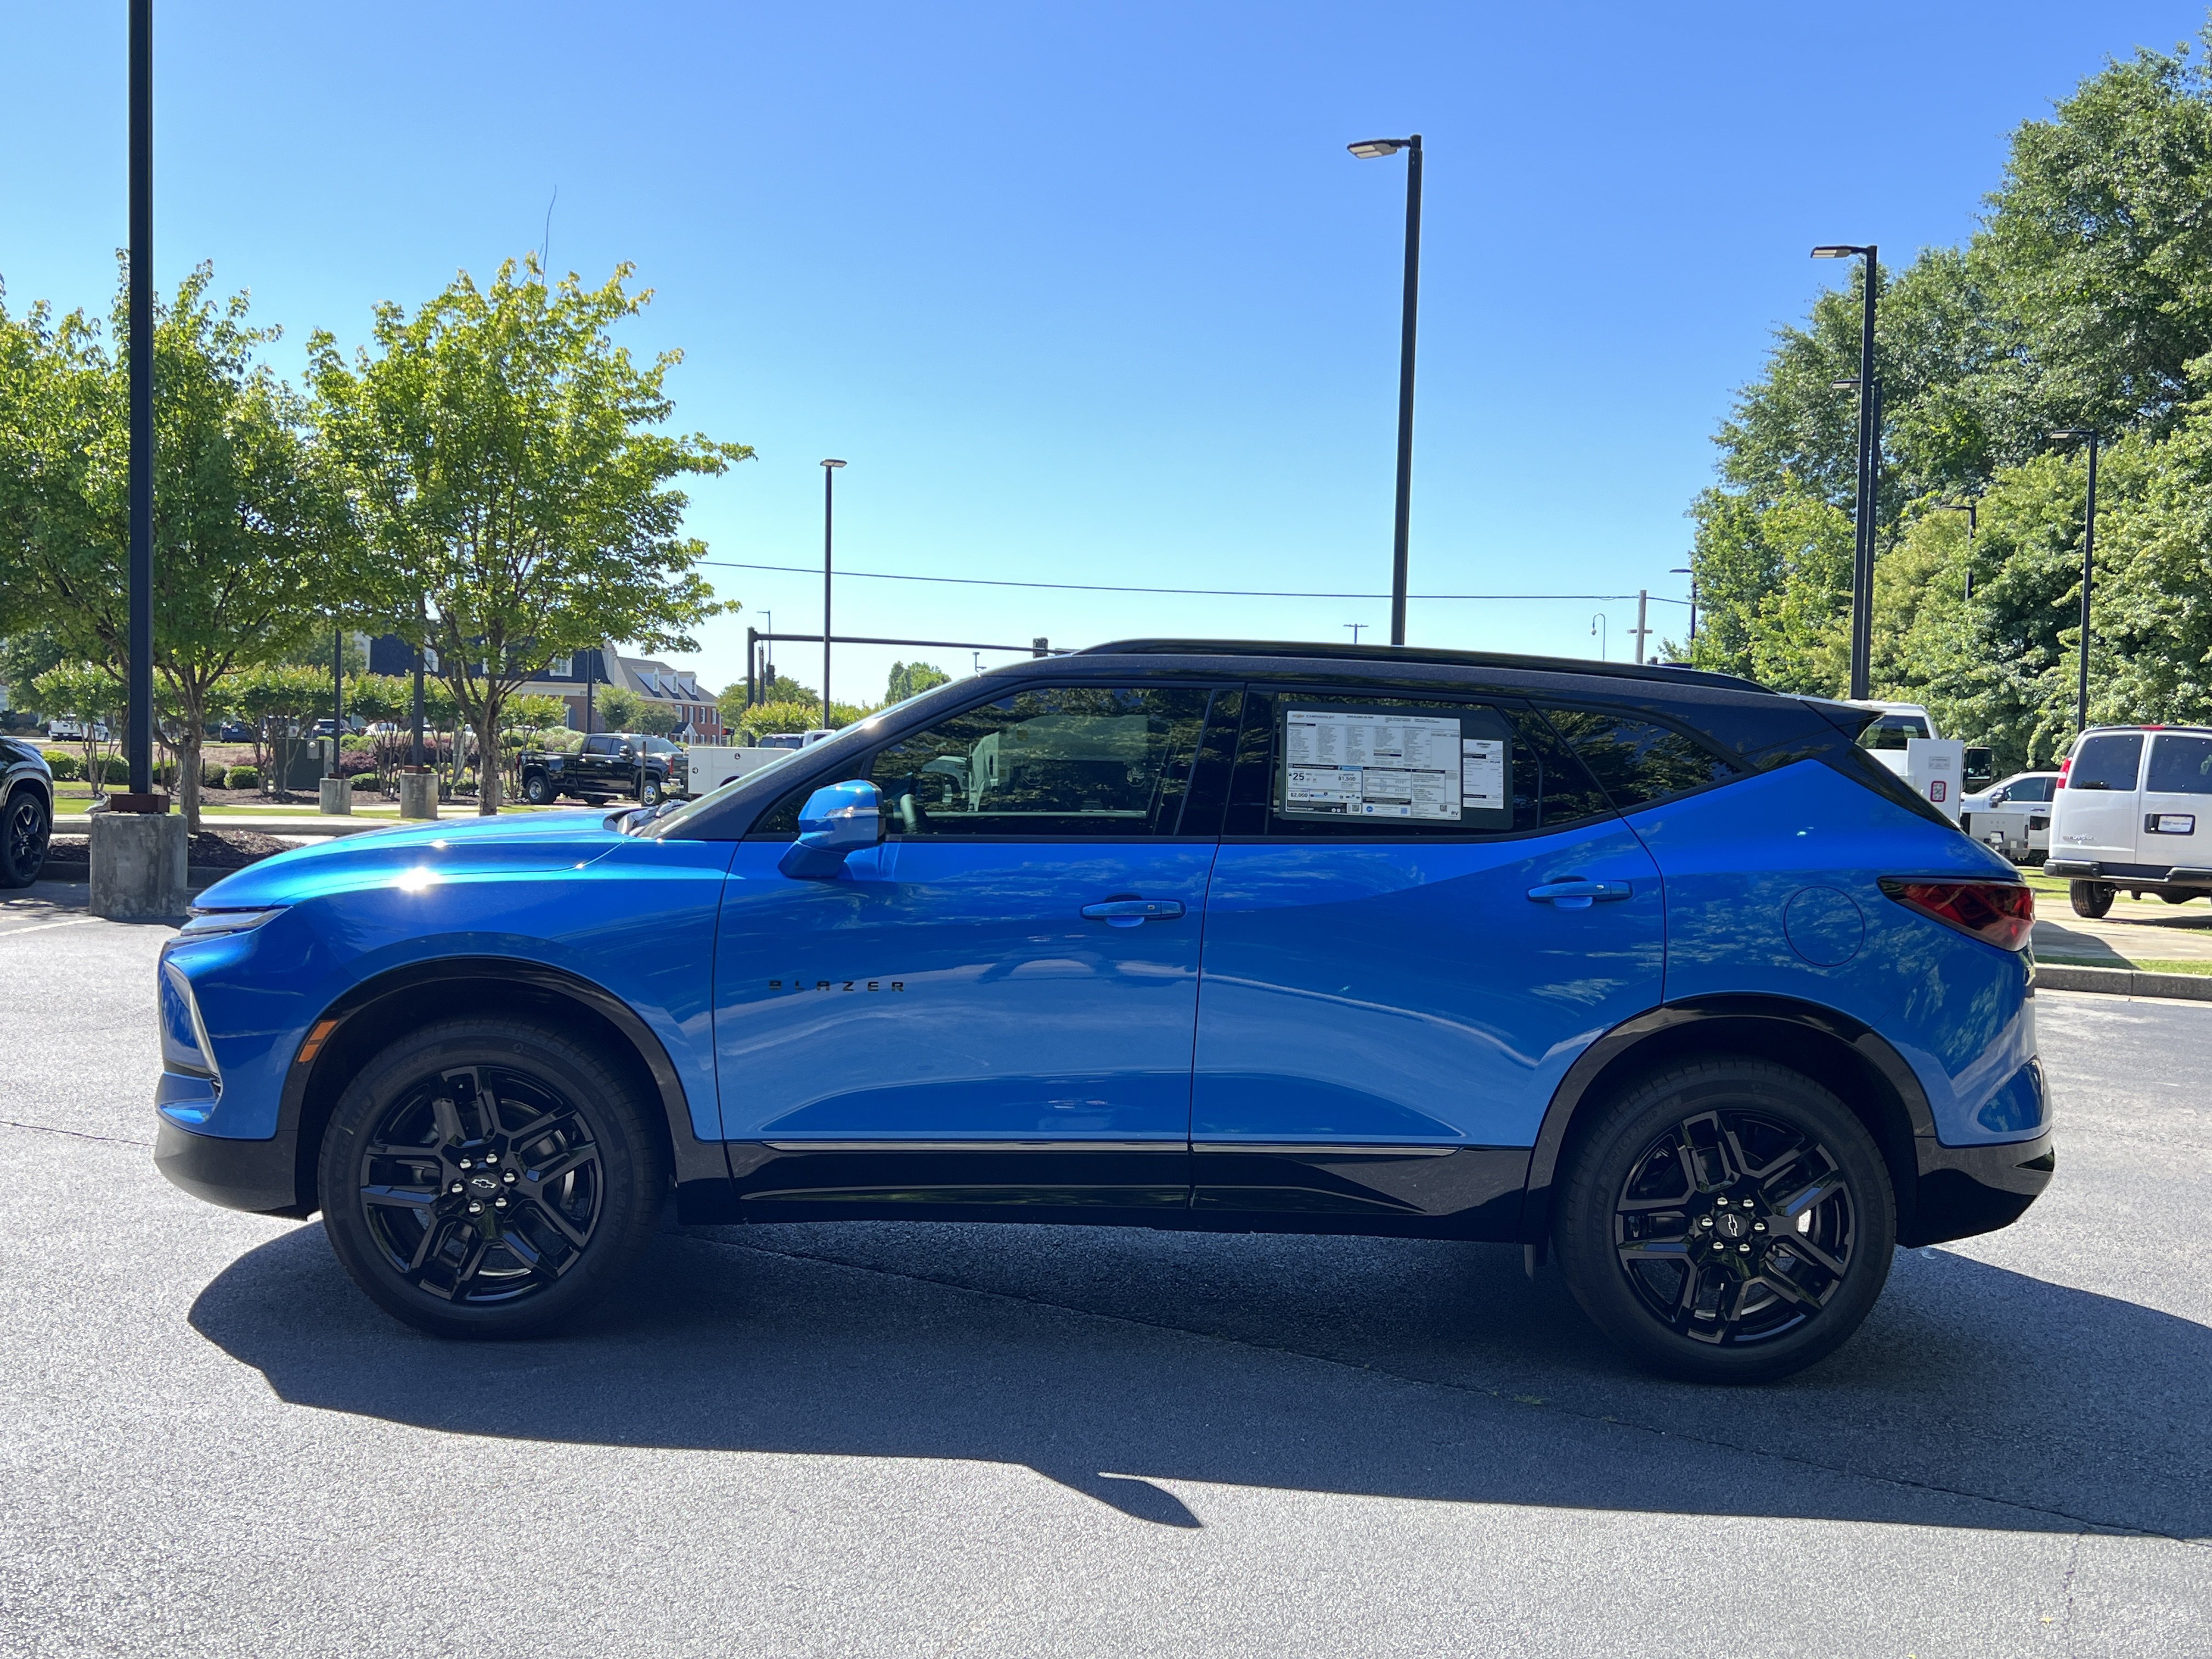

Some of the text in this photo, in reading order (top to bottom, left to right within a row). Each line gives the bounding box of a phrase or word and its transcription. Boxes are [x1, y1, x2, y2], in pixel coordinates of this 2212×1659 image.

[1293, 772, 1305, 781] 25
[769, 980, 904, 992] BLAZER
[1633, 1108, 1660, 1132] TOUR
